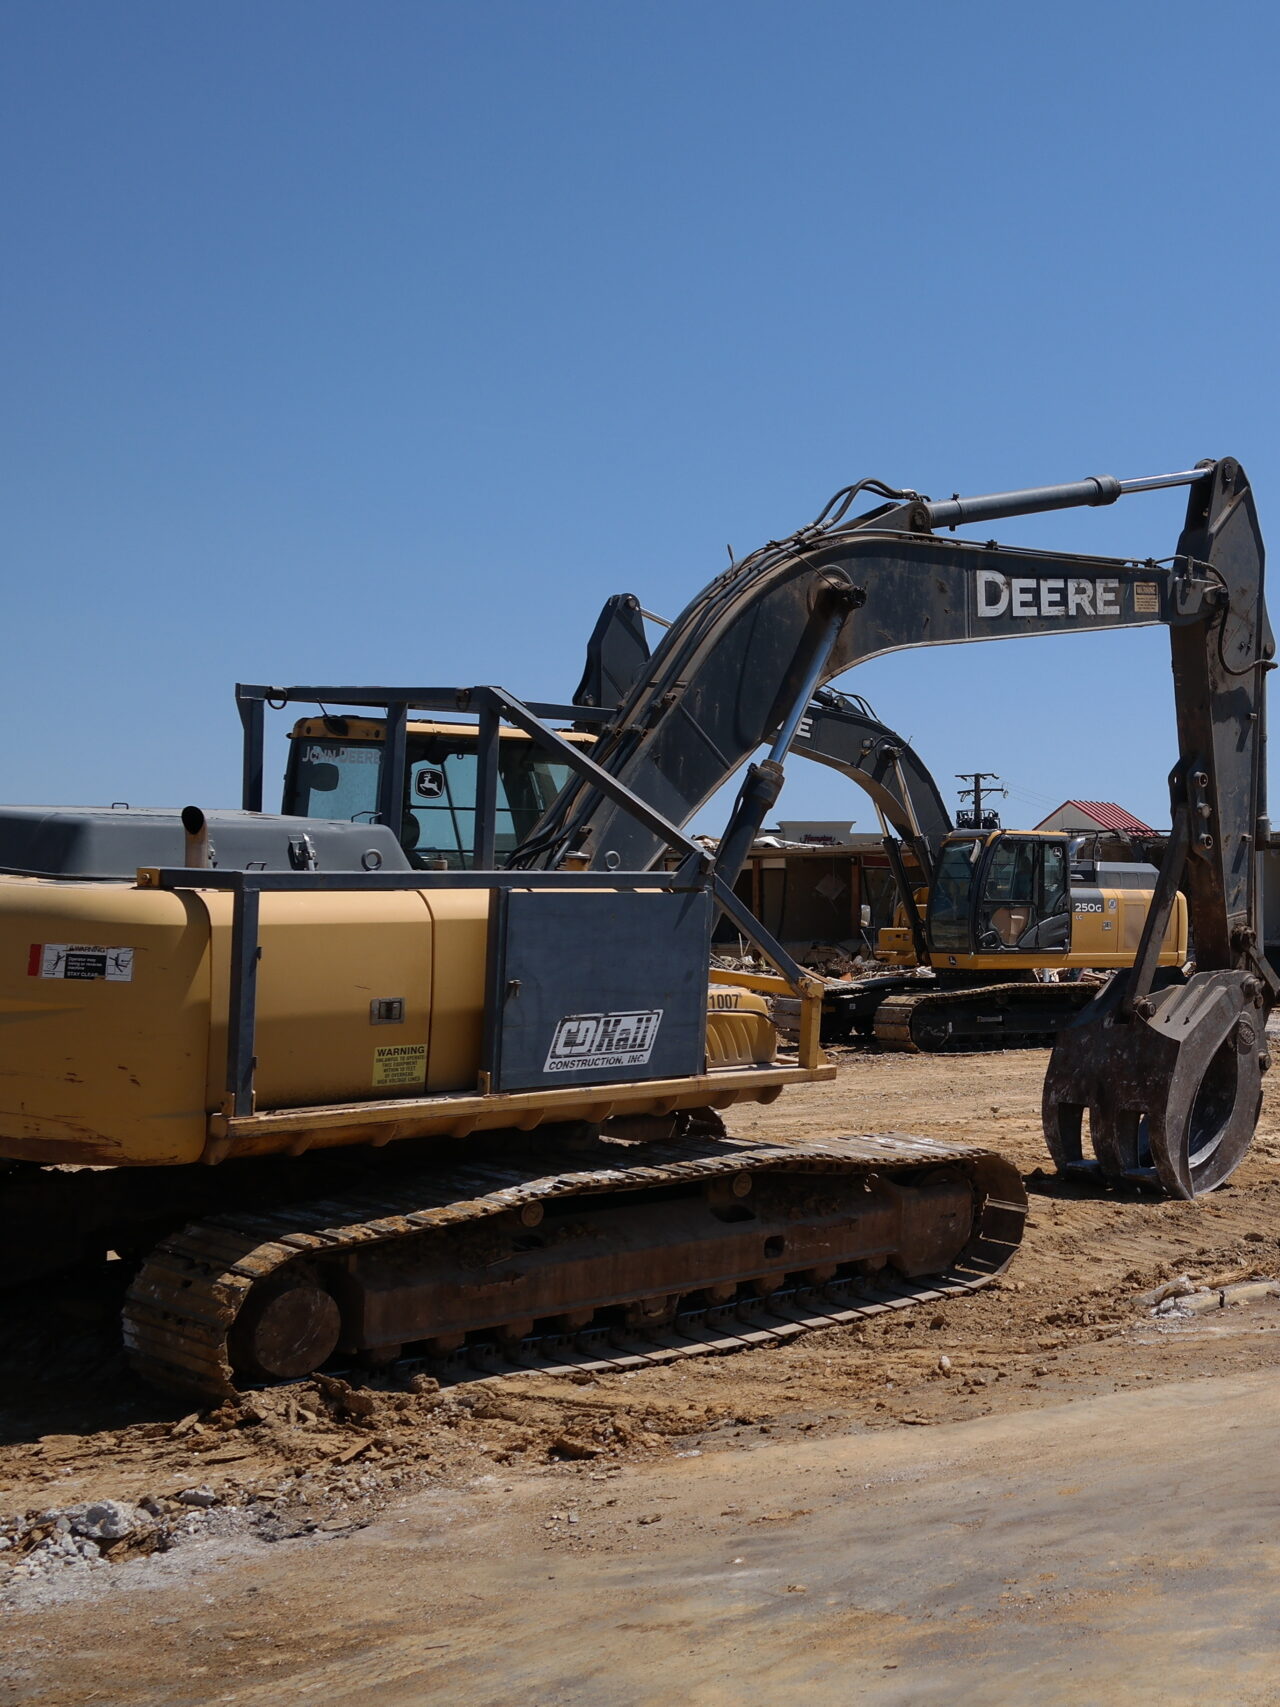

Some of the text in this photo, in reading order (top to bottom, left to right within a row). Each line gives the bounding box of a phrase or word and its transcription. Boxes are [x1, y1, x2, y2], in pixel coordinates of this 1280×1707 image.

[976, 569, 1121, 617] DEERE
[302, 746, 381, 765] JOHN DEERE
[1075, 902, 1102, 913] 250G
[709, 993, 739, 1009] 1007
[555, 1014, 658, 1056] CD Hall
[377, 1045, 425, 1057] WARNING
